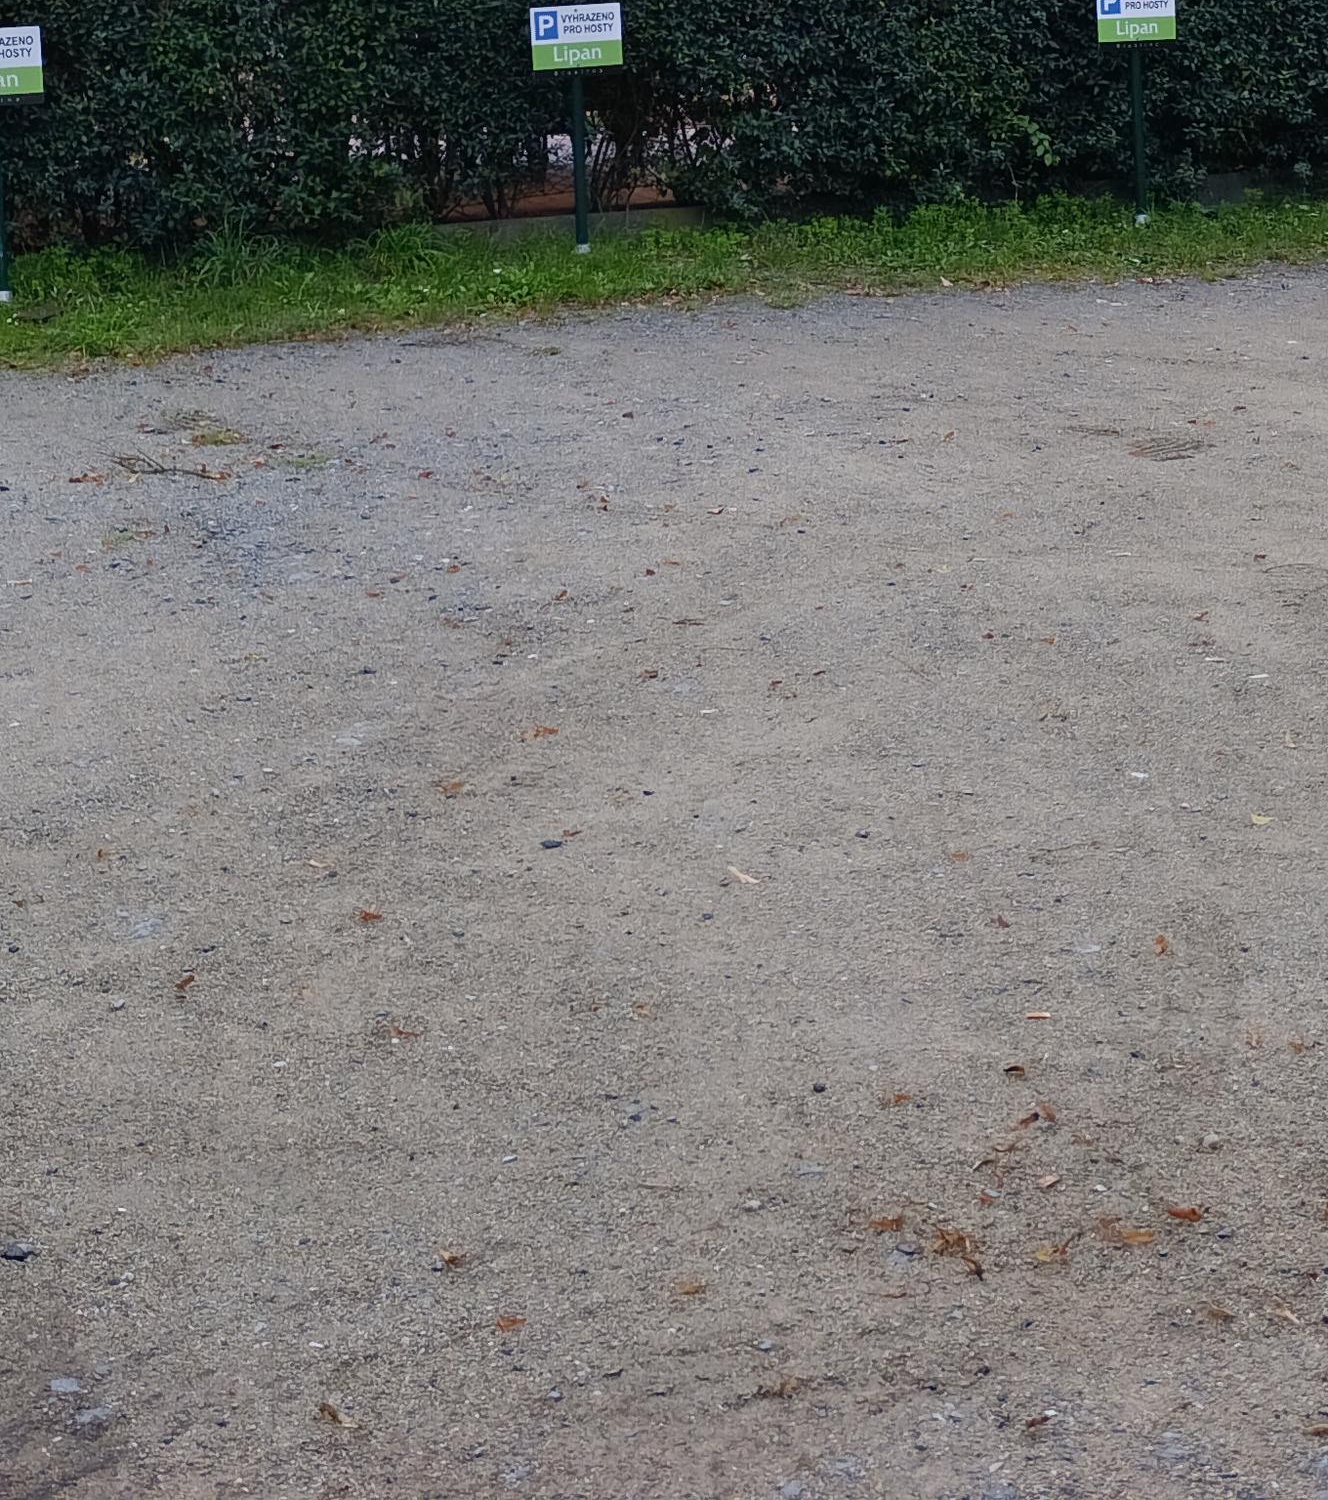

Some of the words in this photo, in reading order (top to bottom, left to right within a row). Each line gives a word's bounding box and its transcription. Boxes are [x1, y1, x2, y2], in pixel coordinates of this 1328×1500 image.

[1125, 1, 1142, 10] PRO
[1143, 0, 1169, 9] HOSTY
[560, 11, 615, 24] VYHRAZENO
[538, 14, 555, 37] P
[563, 24, 583, 35] PRO
[584, 23, 614, 33] HOSTY
[1116, 20, 1158, 38] Lipan
[554, 46, 602, 65] Lipan
